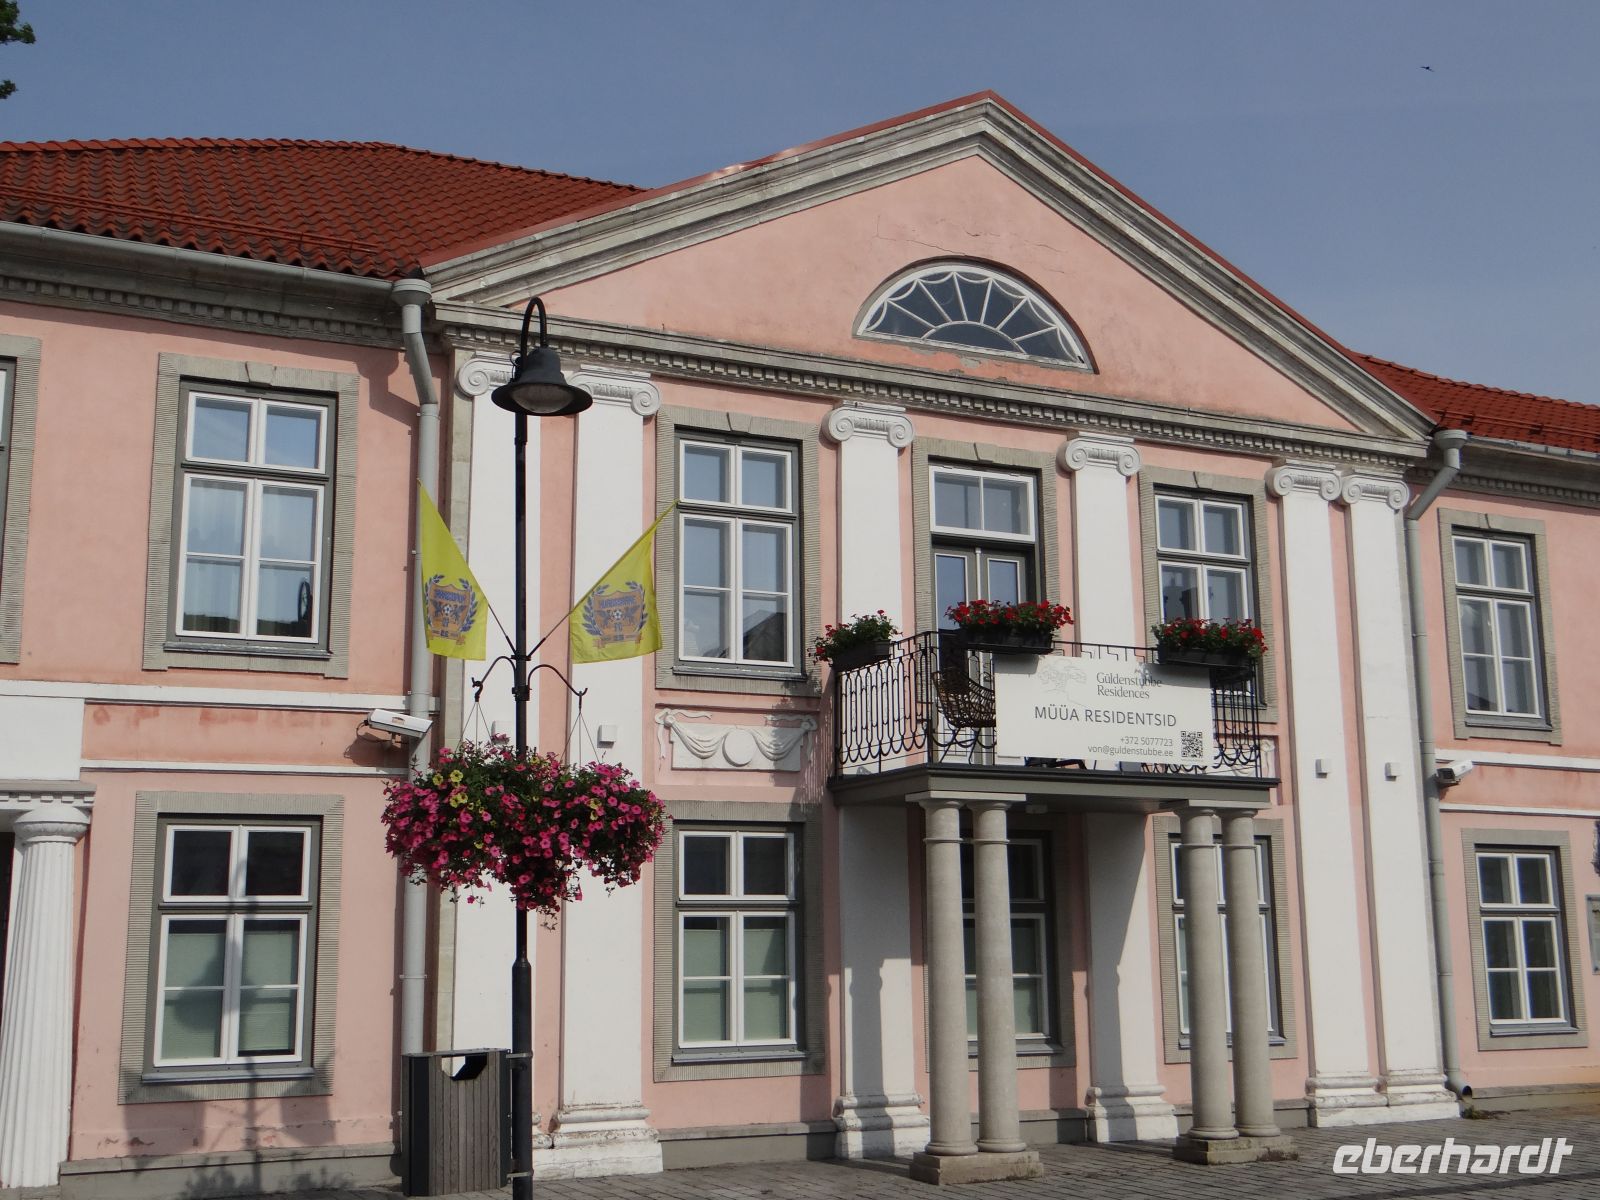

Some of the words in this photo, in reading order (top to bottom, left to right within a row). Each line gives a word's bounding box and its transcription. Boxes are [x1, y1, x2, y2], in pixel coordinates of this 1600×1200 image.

[1097, 684, 1150, 699] Residences
[1034, 703, 1080, 722] MÜÜA
[1085, 709, 1177, 727] RESIDENTSID
[1120, 736, 1139, 745] +372
[1140, 737, 1173, 747] 5077723
[1087, 745, 1173, 757] von@guldenstubbe.ee
